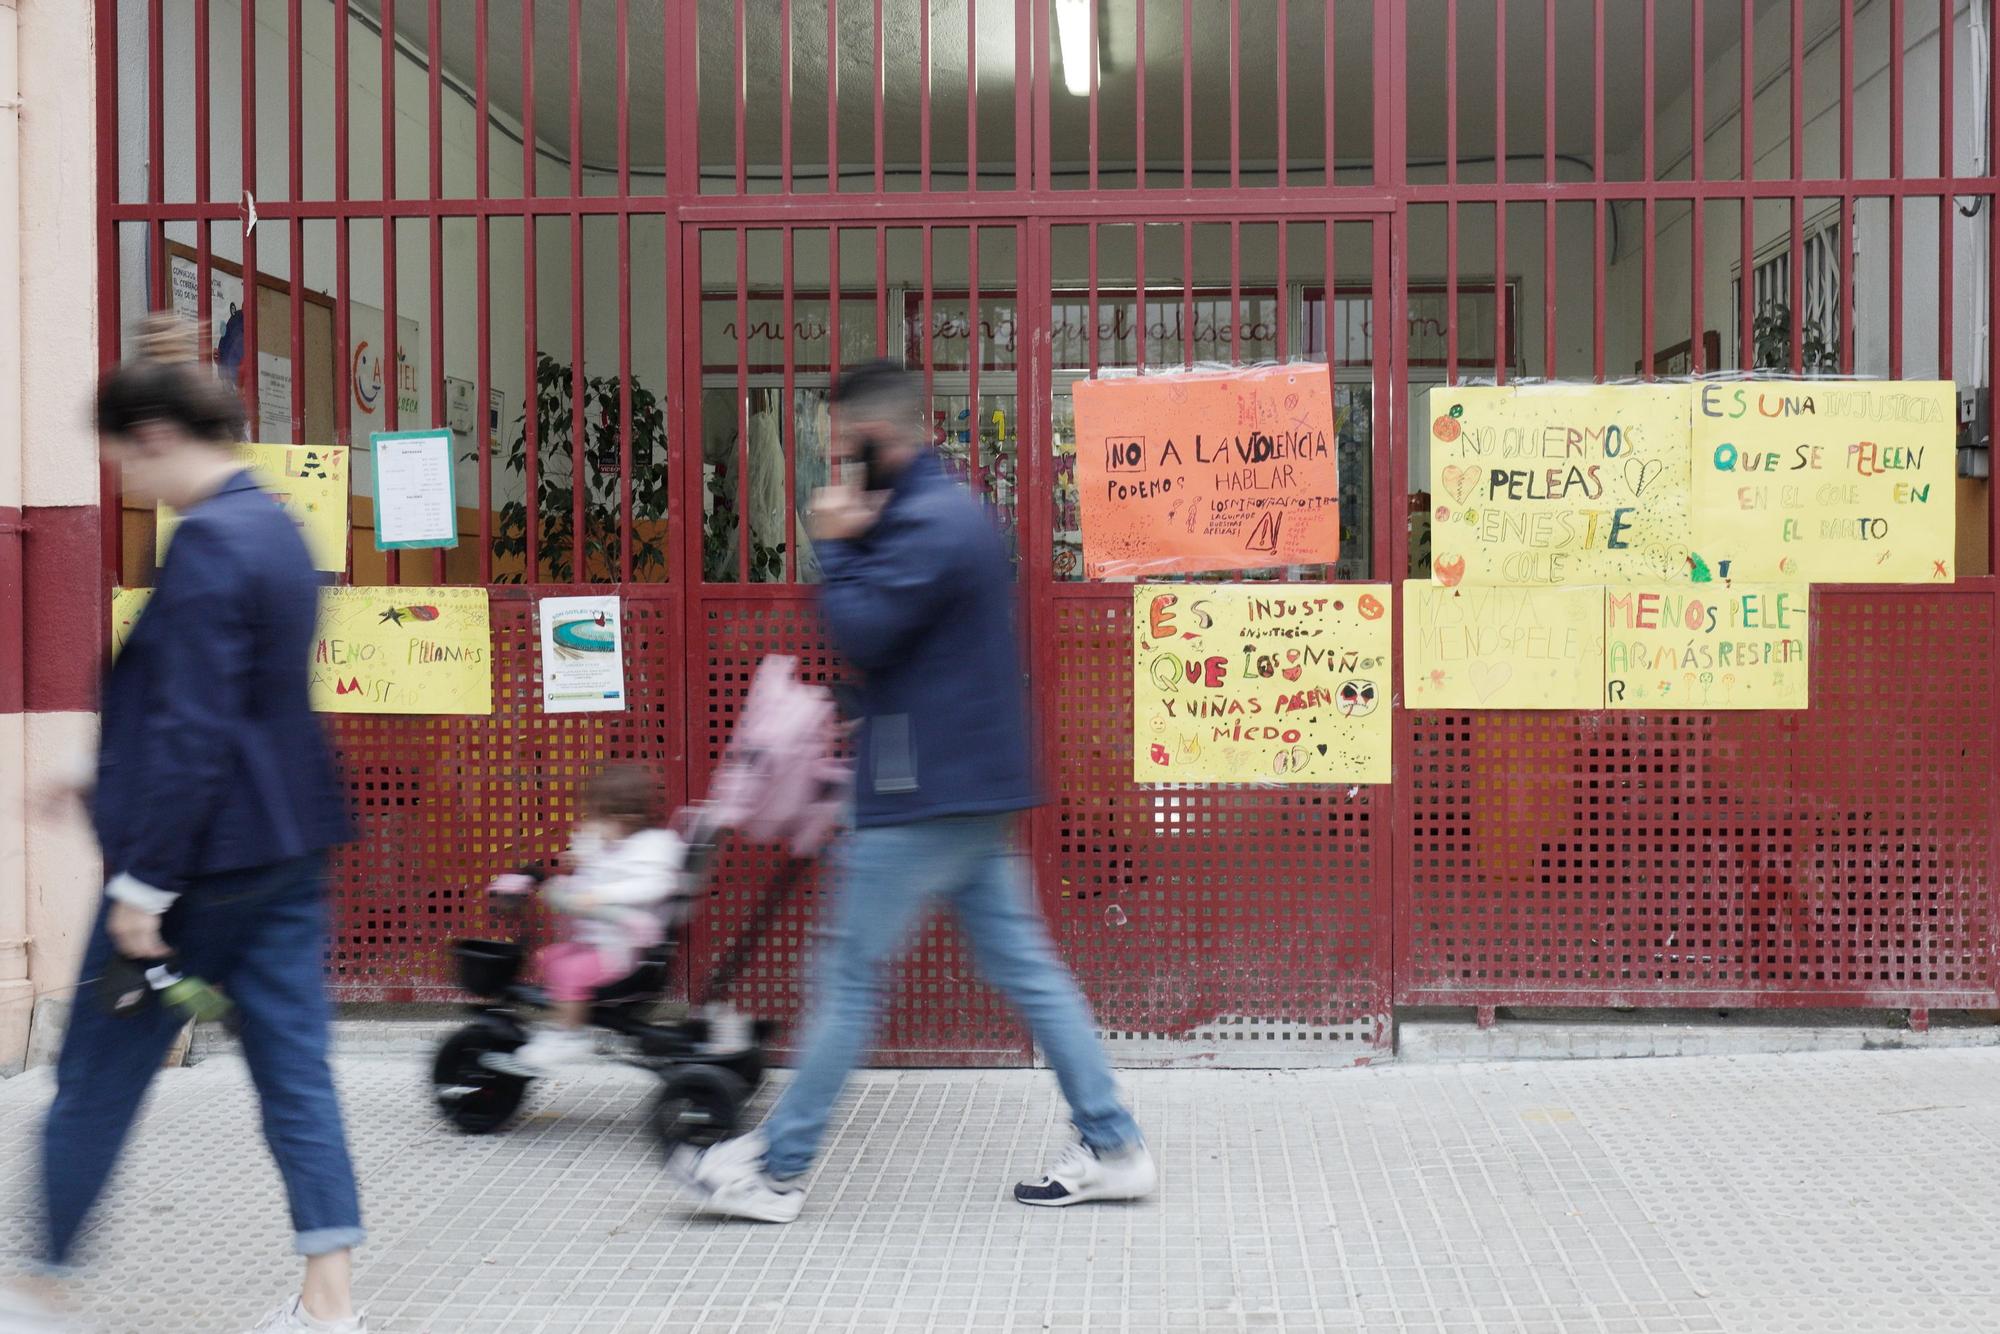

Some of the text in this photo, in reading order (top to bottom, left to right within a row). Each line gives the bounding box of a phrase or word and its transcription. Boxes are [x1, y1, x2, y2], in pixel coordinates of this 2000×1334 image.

[1701, 384, 1747, 419] ES
[1758, 393, 1816, 418] UNA
[1111, 443, 1142, 469] NO
[1159, 439, 1182, 466] A
[1235, 431, 1328, 464] VIOLENCIA
[1713, 442, 1781, 473] QUE
[1790, 444, 1825, 470] SE
[1215, 464, 1297, 491] HABLAR
[1489, 465, 1604, 500] PELEAS
[1893, 482, 1931, 505] EN
[1783, 518, 1804, 542] EL
[1502, 551, 1569, 584] COLE
[1150, 593, 1213, 639] ES
[1608, 591, 1717, 633] MENOS
[1150, 652, 1229, 692] QUE
[1161, 698, 1176, 718] Y
[1608, 680, 1626, 703] R
